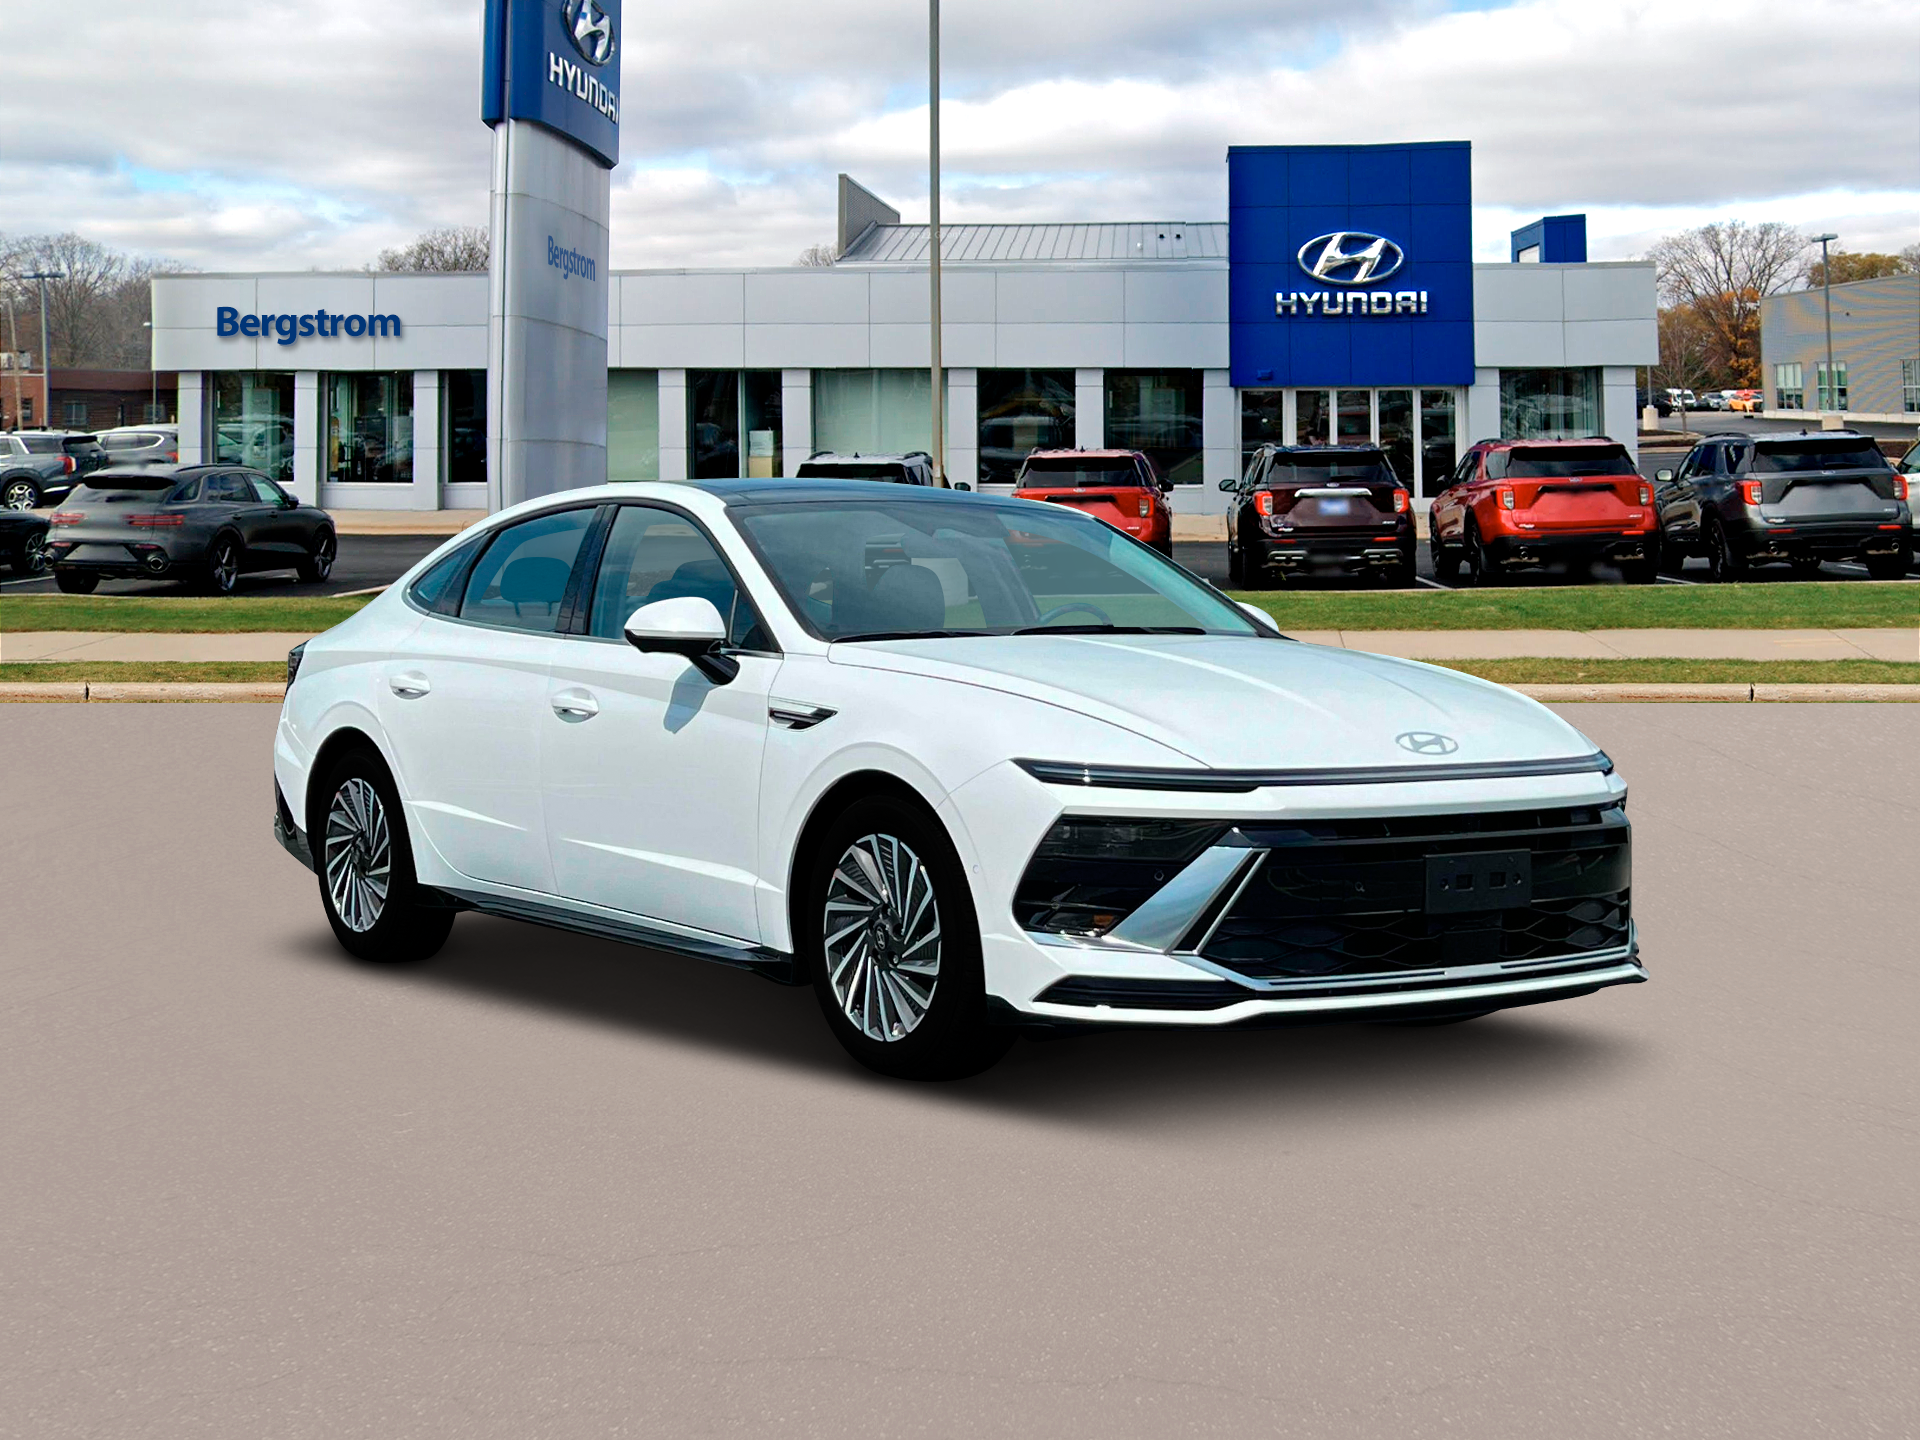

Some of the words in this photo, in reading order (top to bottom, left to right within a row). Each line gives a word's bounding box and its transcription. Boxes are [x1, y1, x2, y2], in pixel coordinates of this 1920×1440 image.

[549, 51, 619, 124] HYUNDAI
[547, 235, 596, 282] Bergstrom
[1275, 291, 1428, 315] HYUNDAI
[216, 306, 401, 346] Bergstrom
